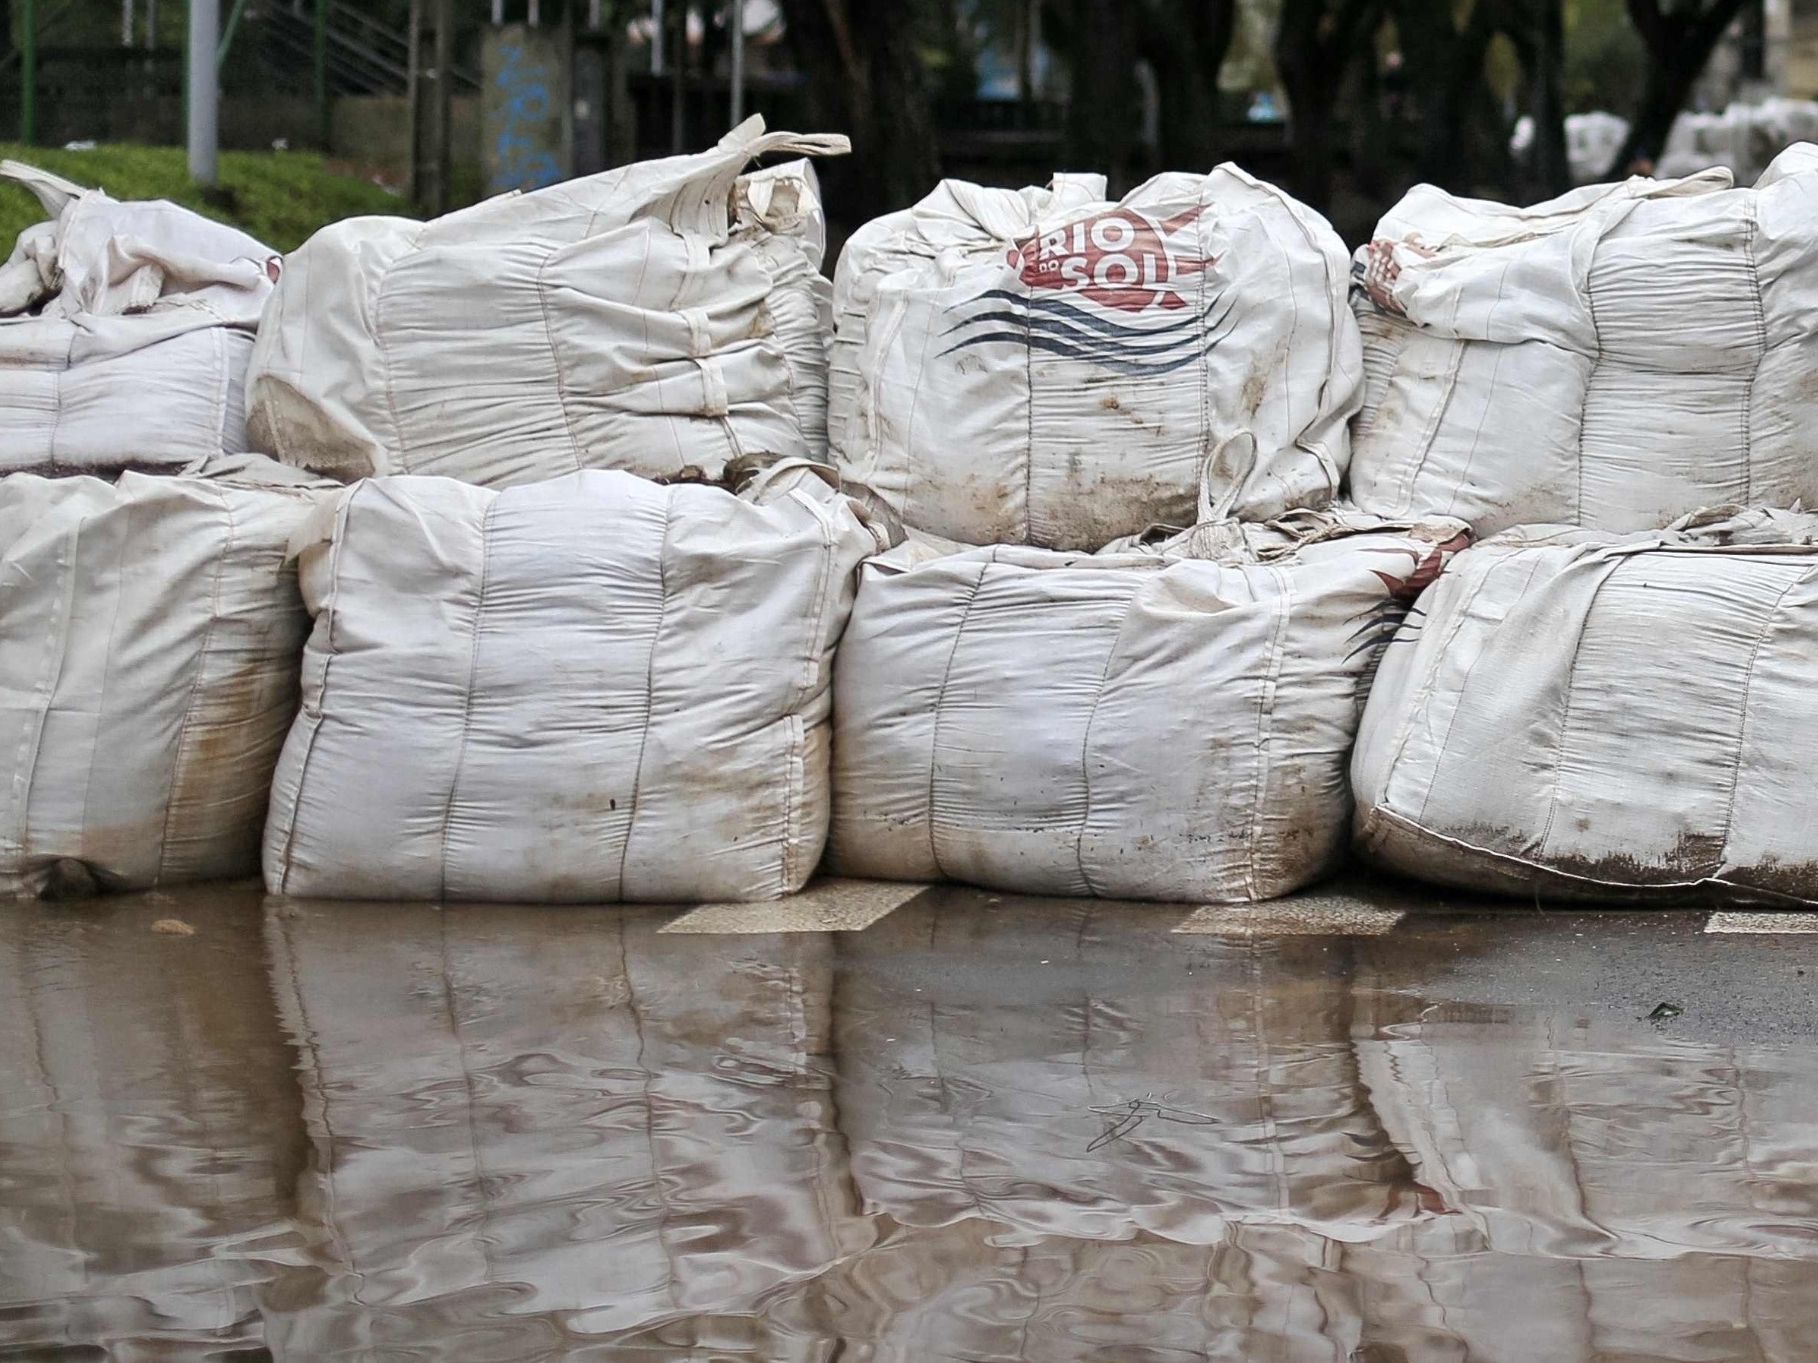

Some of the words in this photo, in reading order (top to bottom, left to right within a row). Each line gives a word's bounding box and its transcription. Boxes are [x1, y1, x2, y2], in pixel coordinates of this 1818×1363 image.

[1039, 217, 1135, 261] RIO
[1039, 259, 1058, 273] DO
[1061, 253, 1165, 292] SOL
